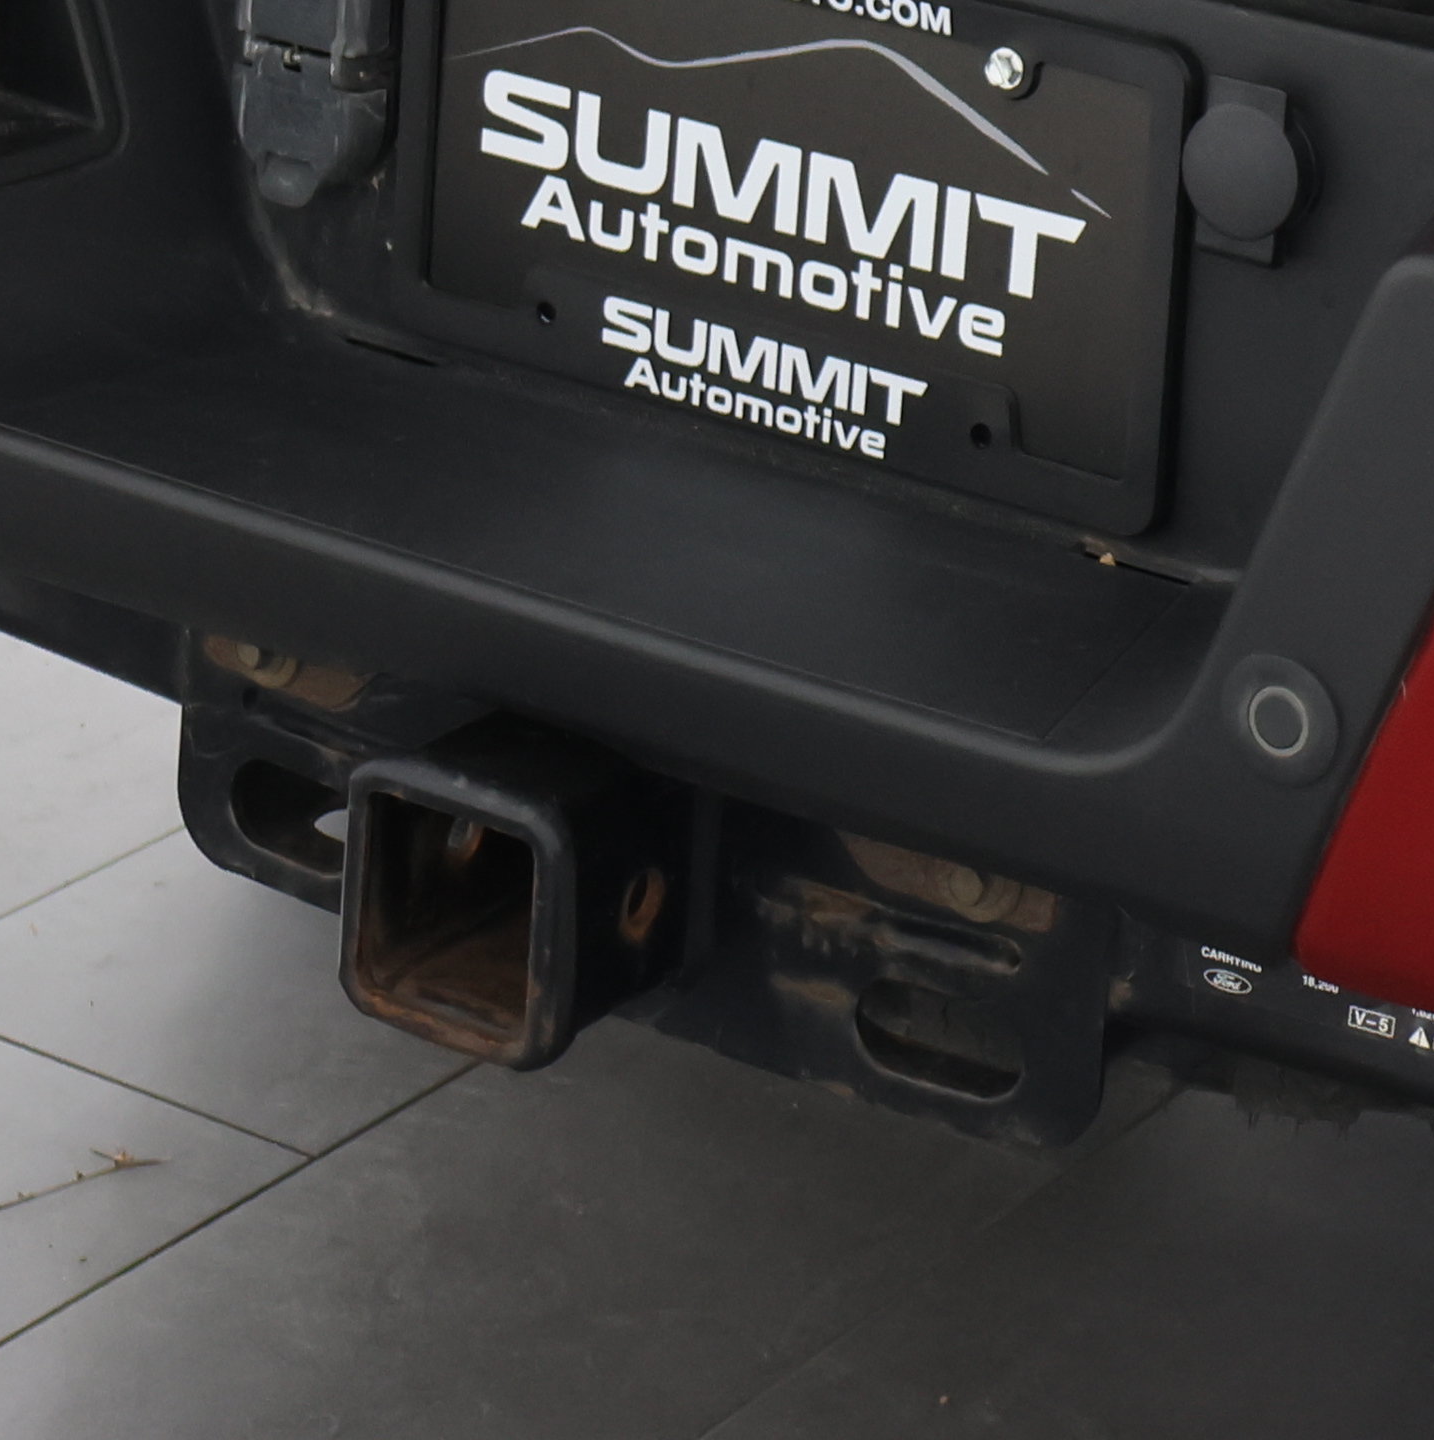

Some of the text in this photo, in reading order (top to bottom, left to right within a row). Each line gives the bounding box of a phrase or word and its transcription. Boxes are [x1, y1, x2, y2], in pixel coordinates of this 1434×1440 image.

[480, 70, 1087, 299] SUMMIT
[521, 175, 1005, 357] Automotive
[602, 296, 928, 425] SUMMIT
[624, 357, 886, 459] Automotive
